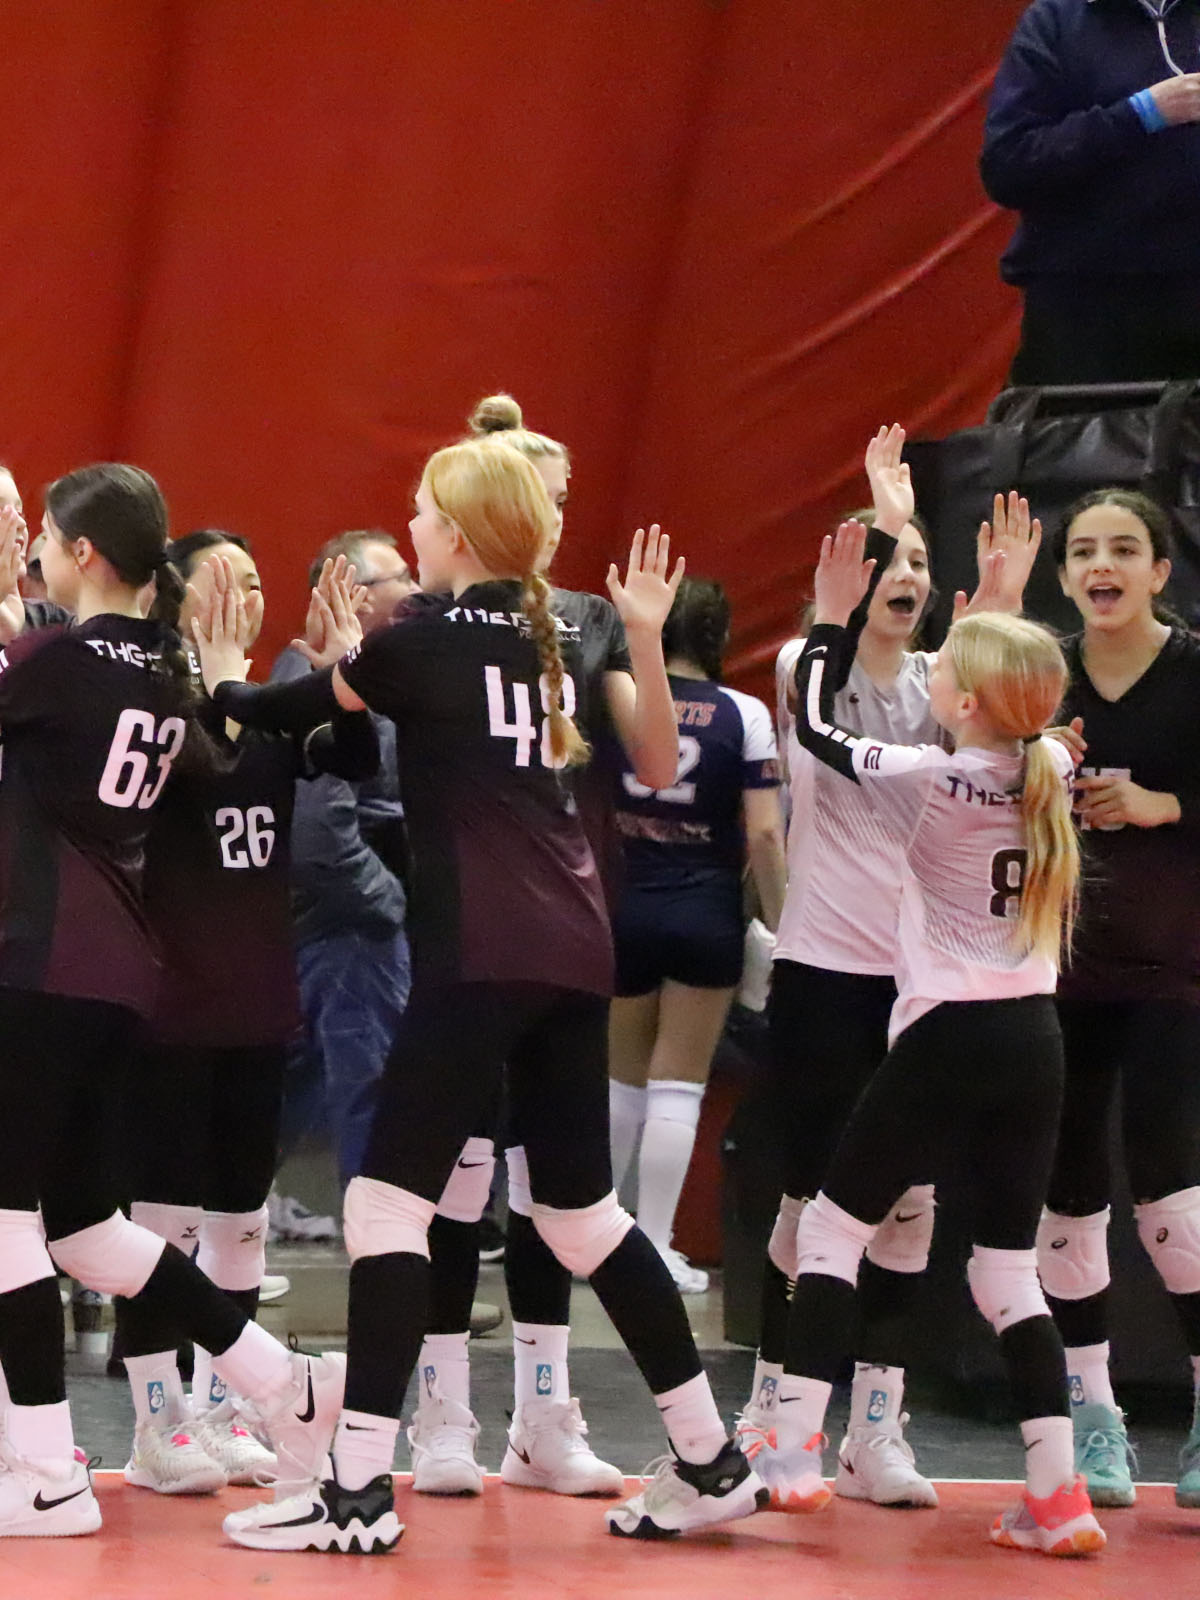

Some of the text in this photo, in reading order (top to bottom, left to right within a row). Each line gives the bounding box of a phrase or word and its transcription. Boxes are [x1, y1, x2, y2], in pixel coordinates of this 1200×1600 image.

[85, 640, 146, 668] THE
[484, 665, 576, 769] 48
[98, 709, 186, 810] 63
[216, 806, 275, 868] 26
[989, 848, 1028, 918] 8
